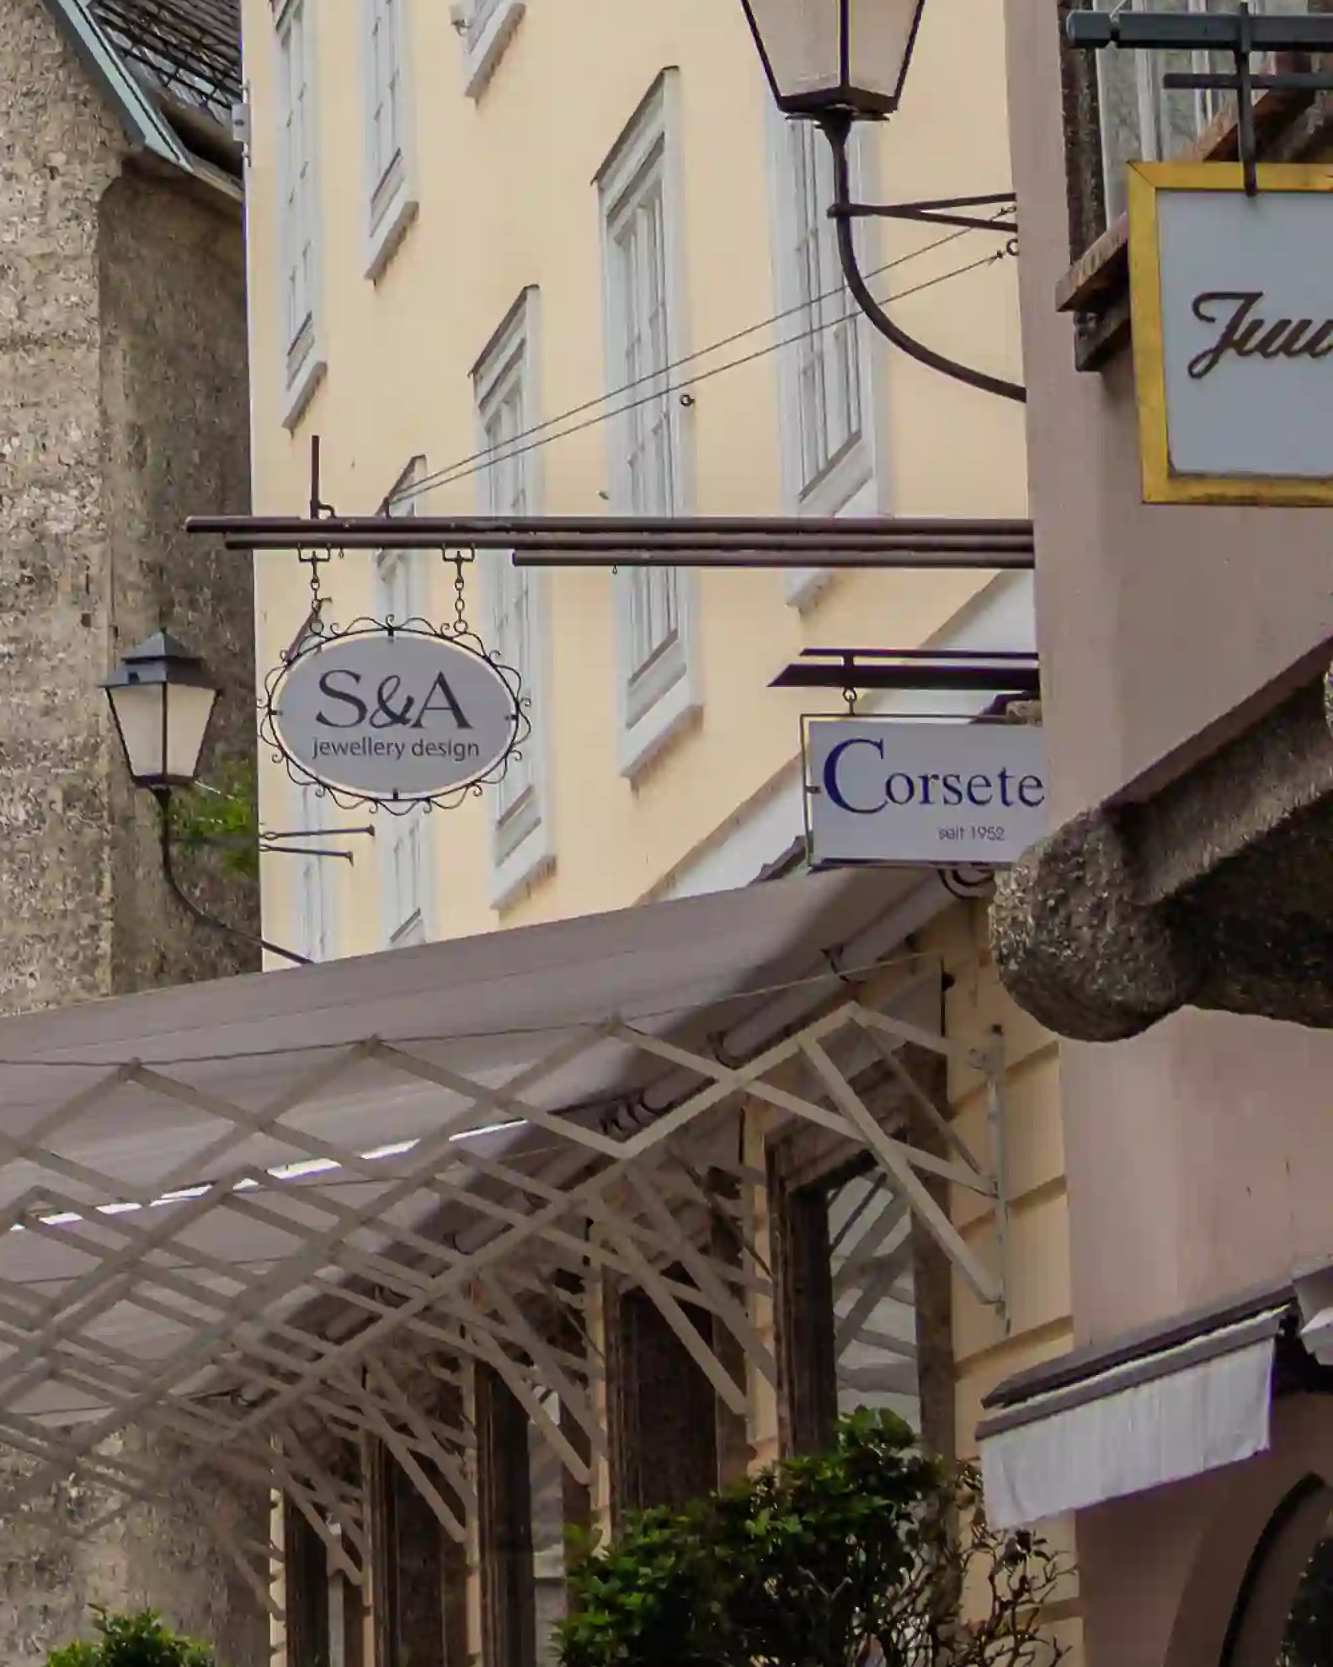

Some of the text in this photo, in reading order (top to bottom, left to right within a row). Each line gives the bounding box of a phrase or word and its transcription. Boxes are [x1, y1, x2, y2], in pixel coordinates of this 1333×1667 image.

[315, 669, 473, 729] S&A
[312, 736, 480, 762] jewellery design
[938, 826, 1006, 841] seit 1952
